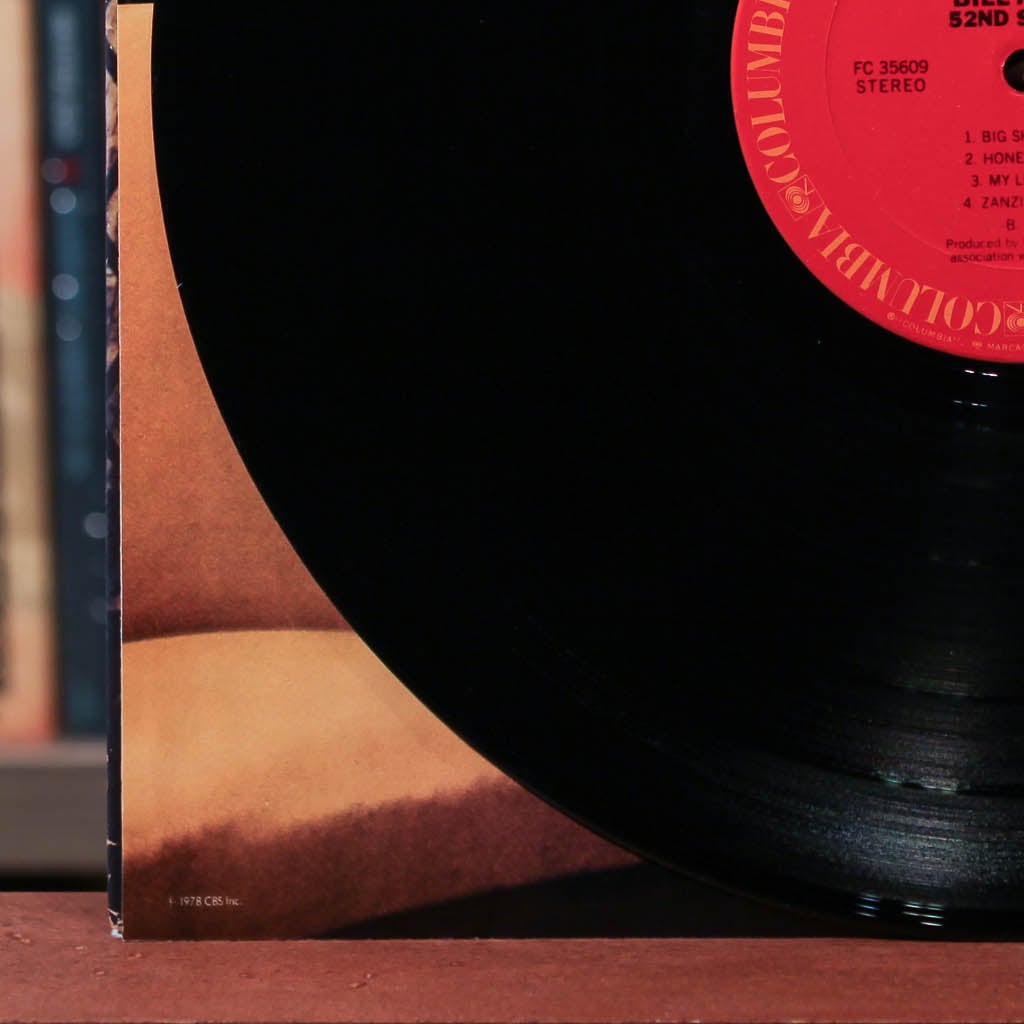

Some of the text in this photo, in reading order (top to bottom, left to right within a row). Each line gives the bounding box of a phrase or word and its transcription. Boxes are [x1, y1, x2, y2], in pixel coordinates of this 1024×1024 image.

[949, 10, 1009, 27] 52ND
[854, 59, 929, 75] FC 35609
[856, 78, 927, 94] STEREO
[981, 131, 1008, 143] BIG
[989, 174, 1010, 186] MY
[946, 238, 1001, 249] Produced
[950, 252, 1014, 264] association
[808, 207, 1001, 336] COLUMBIA
[180, 896, 202, 907] 1978
[204, 896, 224, 907] CBS
